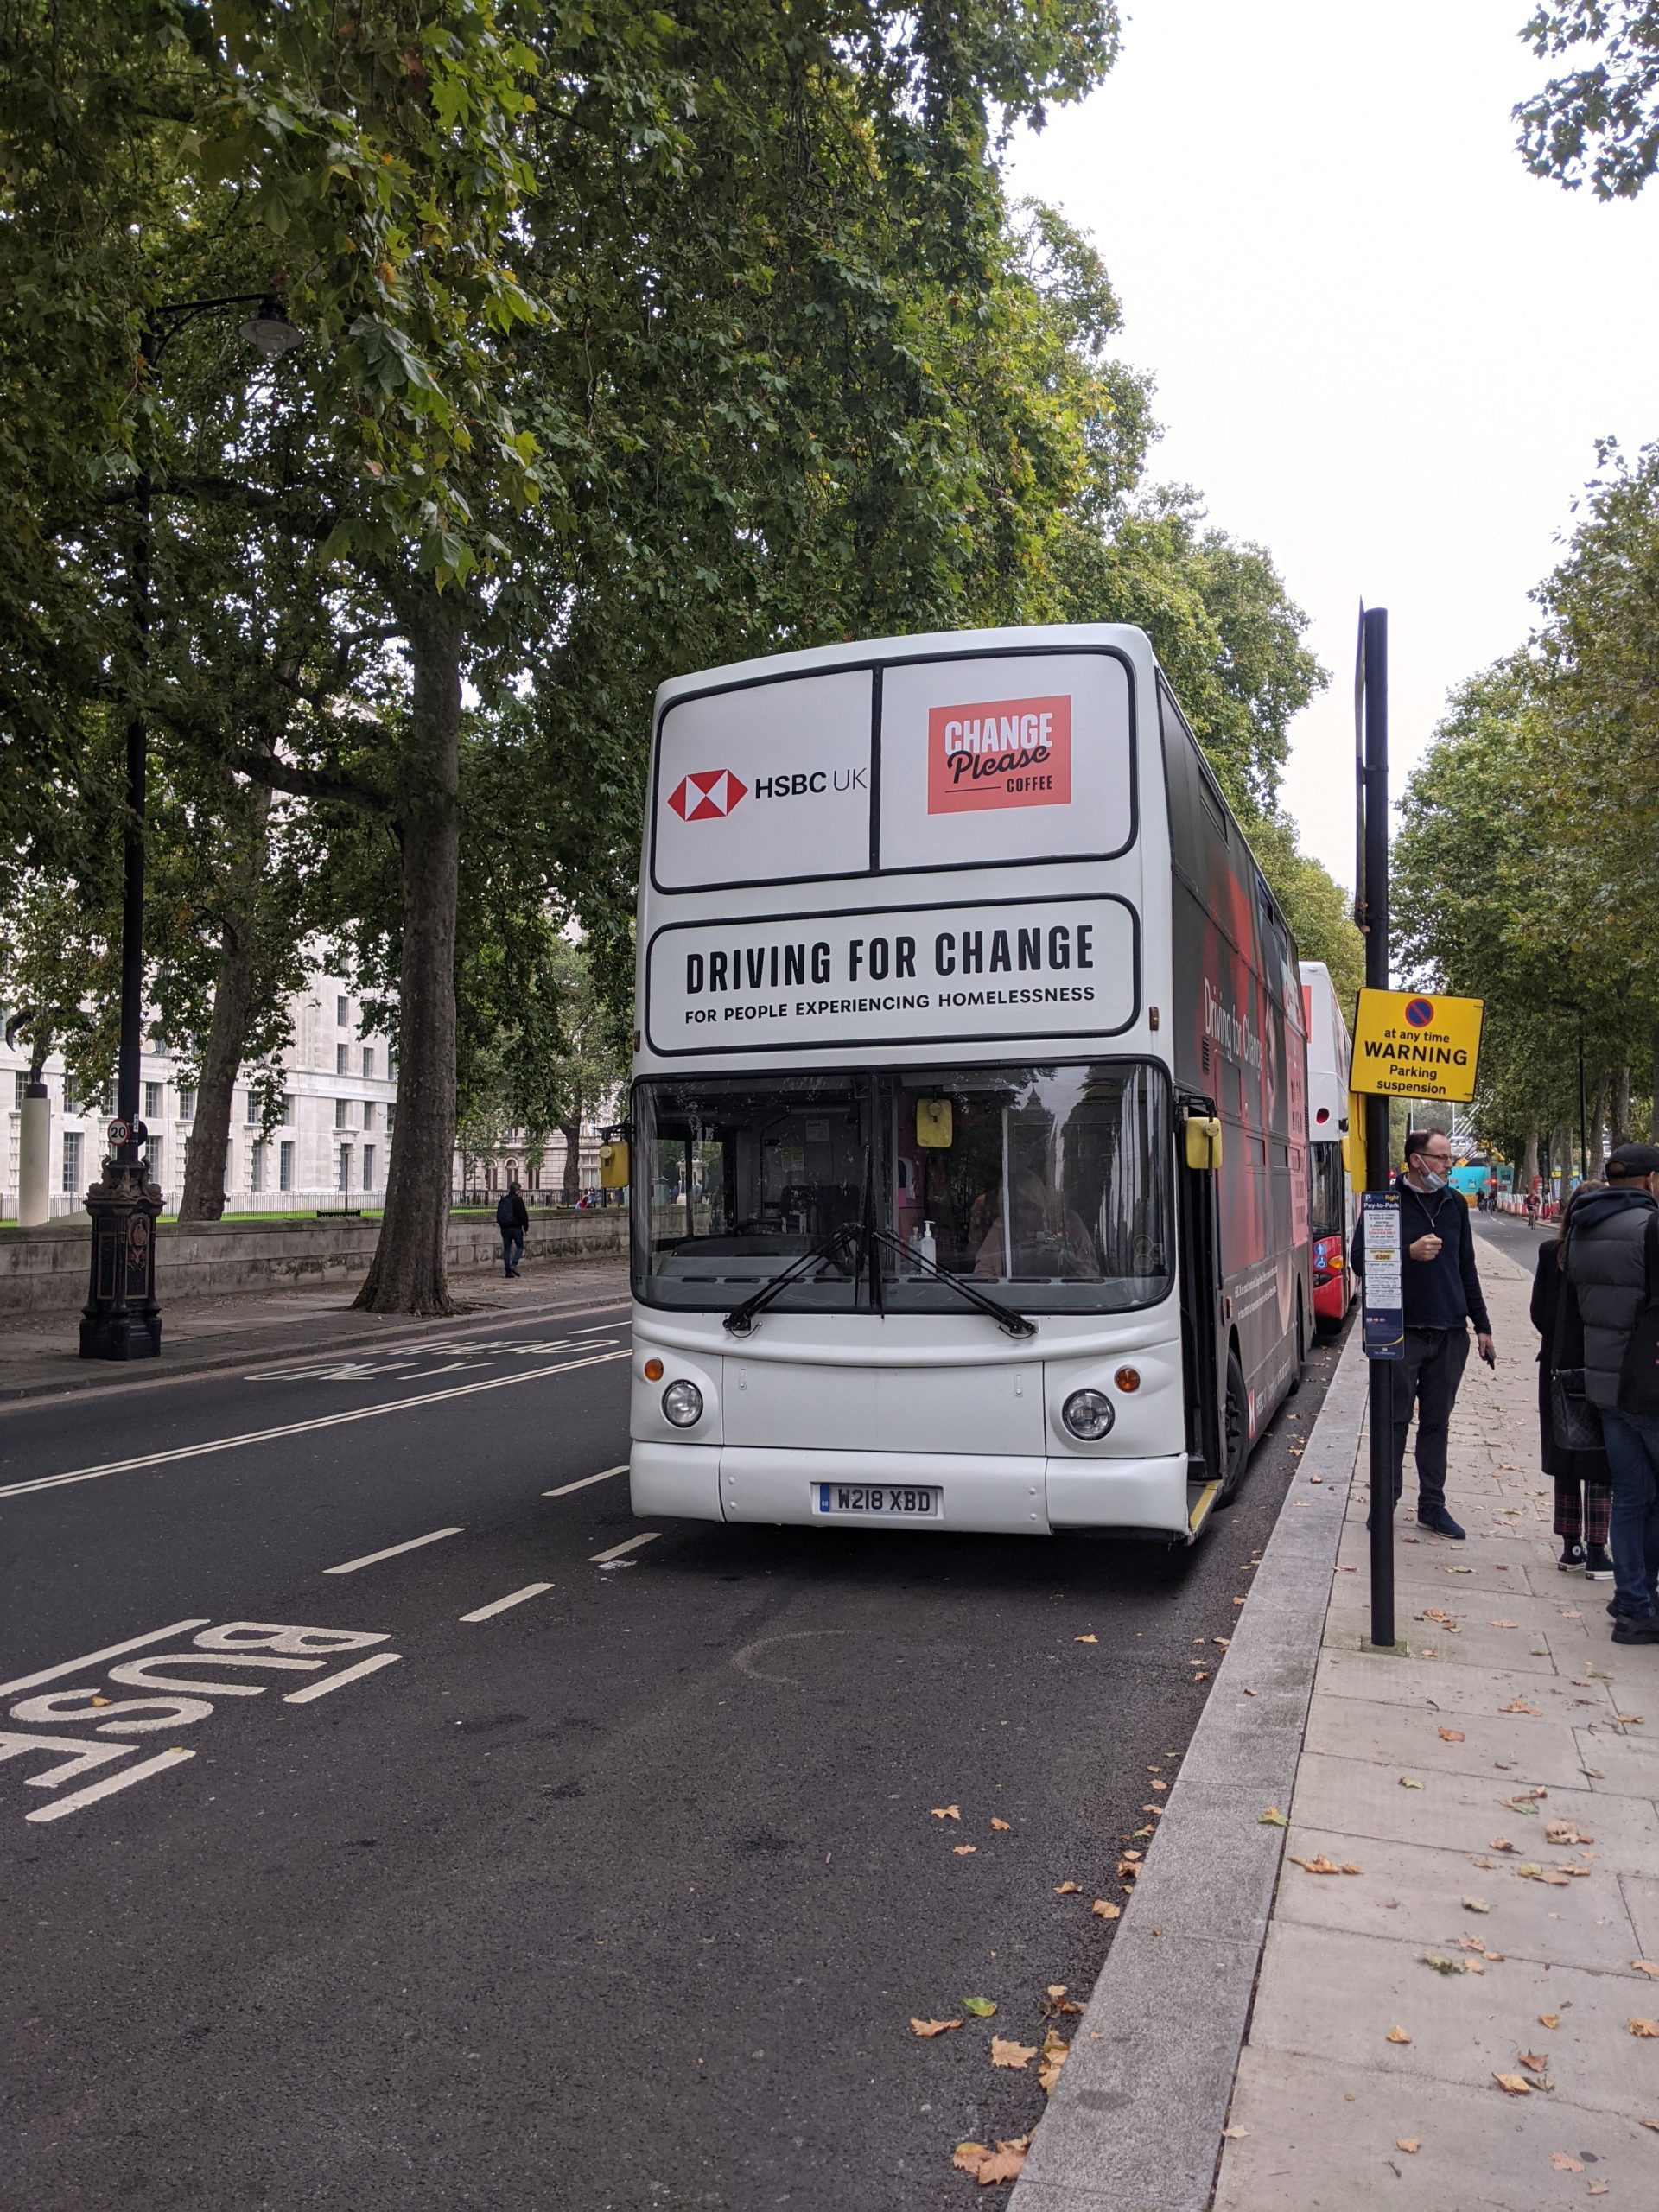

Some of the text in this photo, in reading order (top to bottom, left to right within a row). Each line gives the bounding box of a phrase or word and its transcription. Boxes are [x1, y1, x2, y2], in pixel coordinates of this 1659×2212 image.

[944, 712, 1053, 757] CHANGE
[947, 745, 1051, 784] Please
[755, 767, 868, 799] HSBC UK
[1007, 775, 1053, 792] COFFEE
[686, 925, 1094, 995] DRIVING FOR CHANGE
[685, 986, 1095, 1024] FOR PEOPLE EXPERIENCING HOMELESSNESS
[1205, 976, 1233, 1063] Driving
[1384, 1028, 1450, 1043] at any time
[1364, 1041, 1467, 1065] WARNING
[1389, 1064, 1437, 1081] Parking
[1376, 1080, 1446, 1095] suspension
[111, 1127, 126, 1138] 20
[243, 1362, 499, 1381] ONLY
[838, 1488, 931, 1512] W218 XBD
